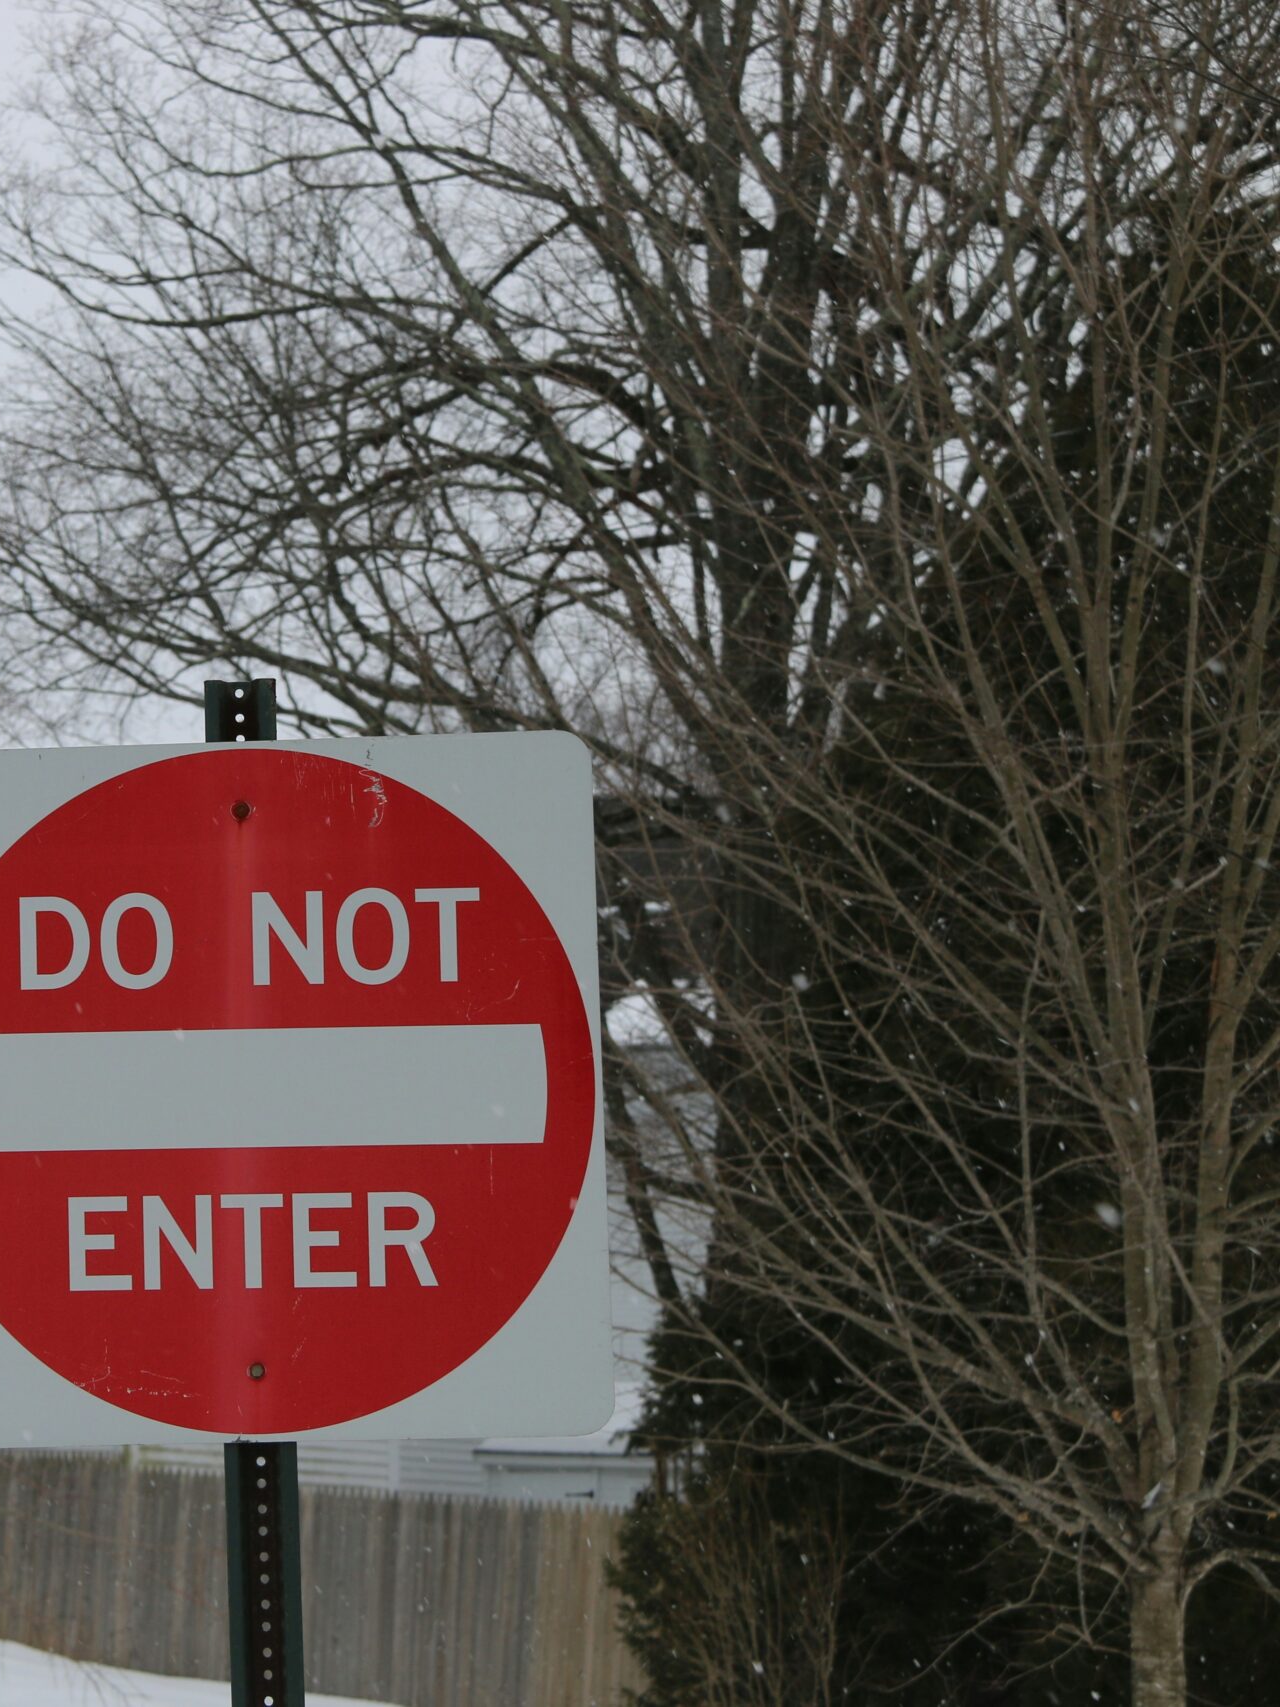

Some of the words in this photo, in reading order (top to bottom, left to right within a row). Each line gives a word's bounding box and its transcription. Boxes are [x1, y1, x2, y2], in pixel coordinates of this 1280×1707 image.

[19, 892, 174, 990] DO
[252, 888, 480, 985] NOT
[67, 1192, 439, 1291] ENTER
